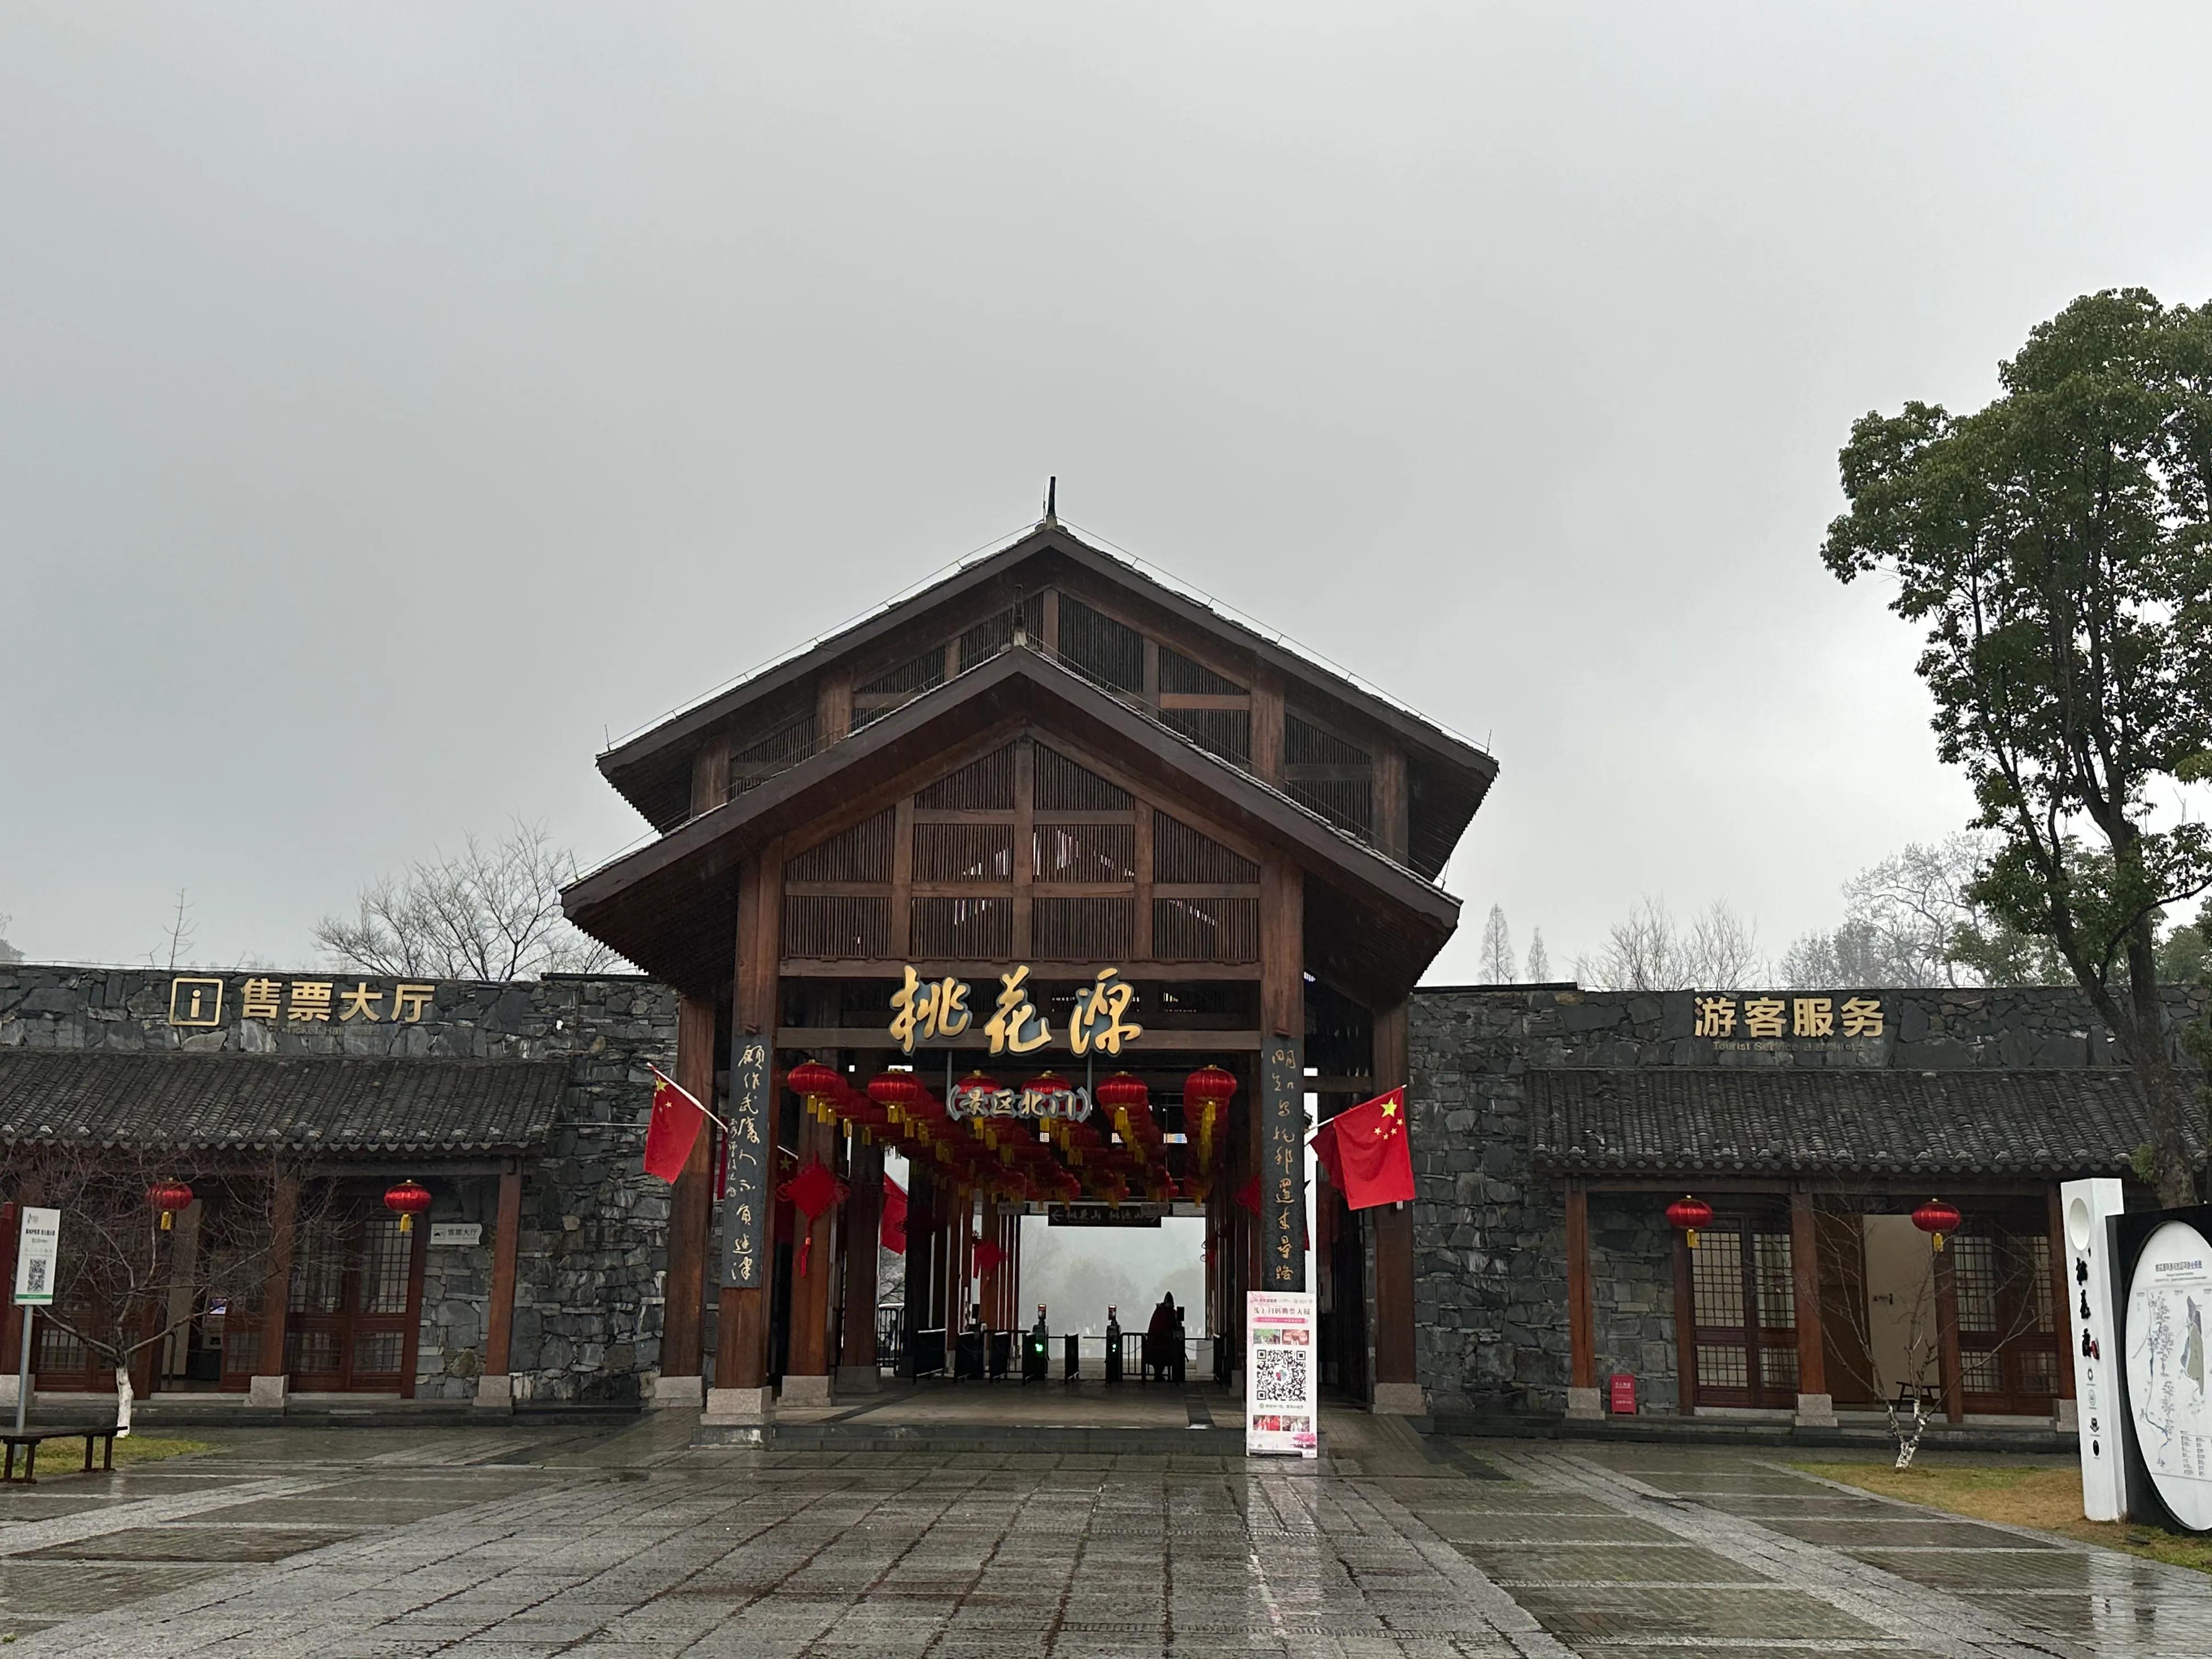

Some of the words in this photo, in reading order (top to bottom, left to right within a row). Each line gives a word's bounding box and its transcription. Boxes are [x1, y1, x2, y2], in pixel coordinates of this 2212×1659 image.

[240, 978, 436, 1023] 售票大厅
[889, 964, 1142, 1055] 桃花源
[1694, 996, 1884, 1038] 游客服务
[1713, 1041, 1751, 1051] Tourist
